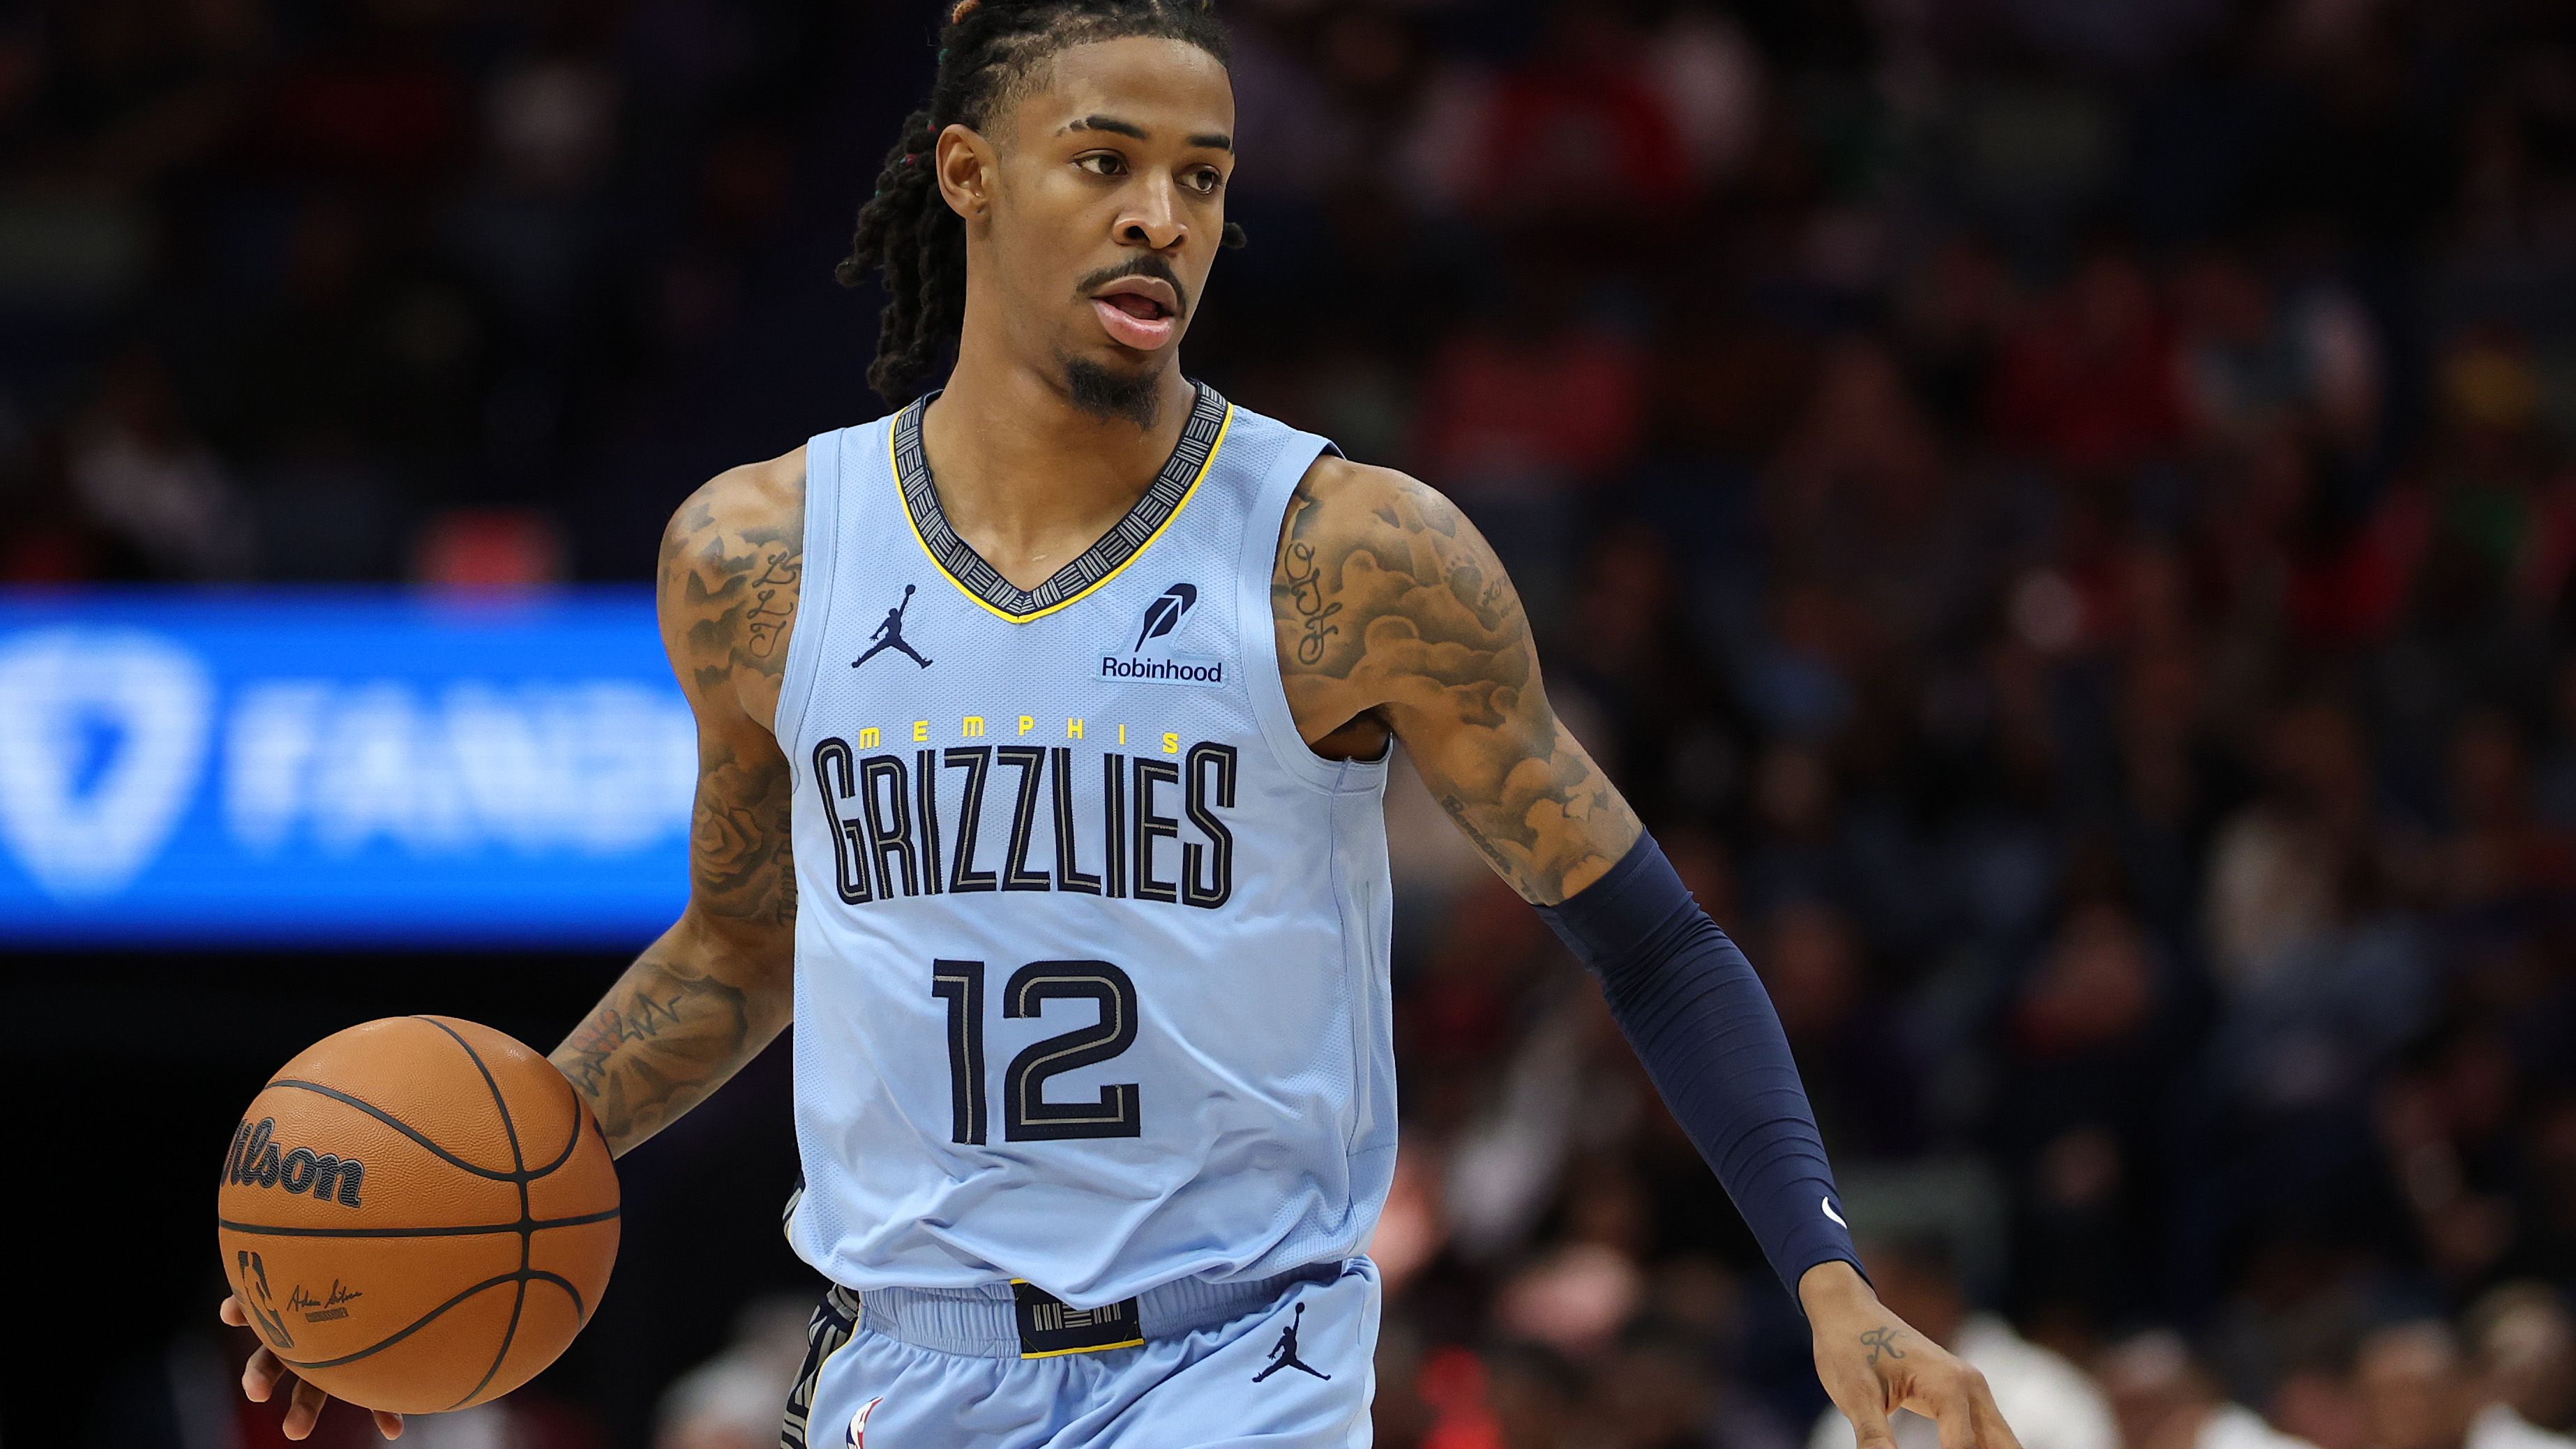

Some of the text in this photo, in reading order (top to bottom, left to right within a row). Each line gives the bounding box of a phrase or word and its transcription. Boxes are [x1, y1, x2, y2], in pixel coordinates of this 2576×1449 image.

[1102, 657, 1221, 682] Robinhood
[859, 715, 1179, 754] MEMPHIS
[813, 737, 1237, 909] GRIZZLIES
[932, 959, 1141, 1146] 12
